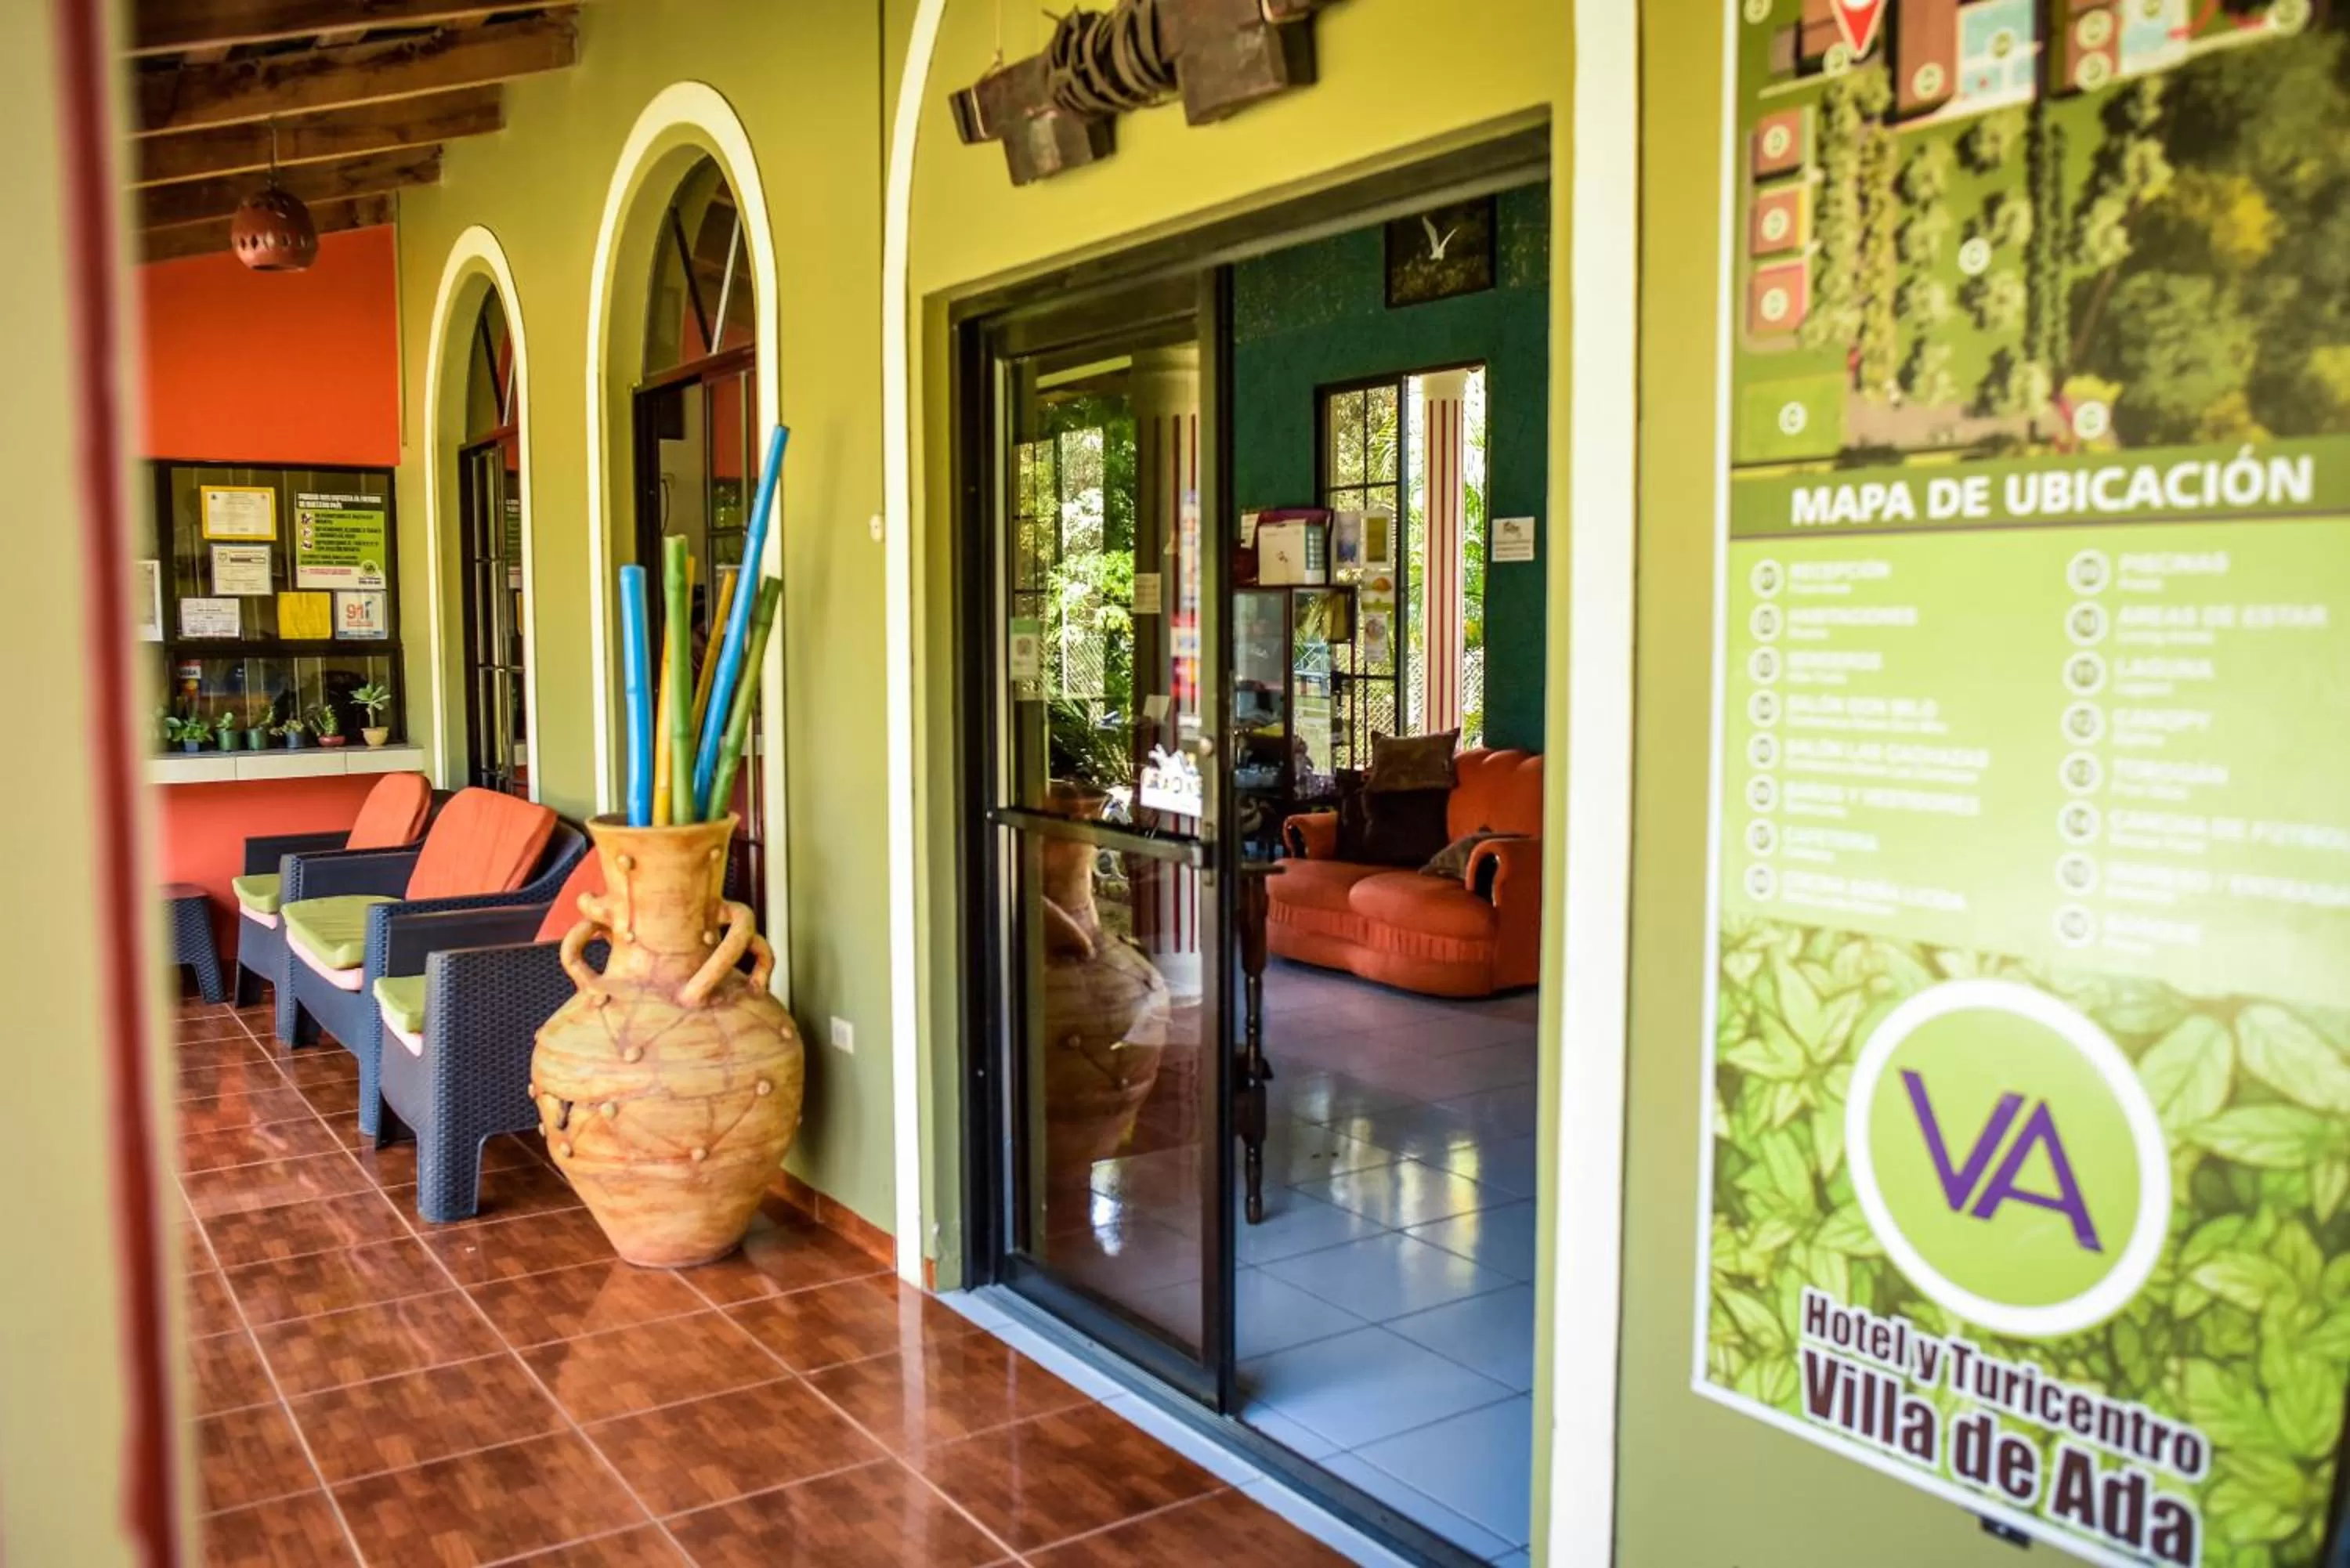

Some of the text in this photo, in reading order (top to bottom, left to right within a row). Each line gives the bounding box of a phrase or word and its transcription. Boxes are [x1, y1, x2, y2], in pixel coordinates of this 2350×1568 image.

[1790, 444, 2314, 526] MAPA DE UBICACIÓN
[1902, 1070, 2102, 1252] VA
[1802, 1348, 2193, 1566] Villa de Ada
[1806, 1293, 2204, 1475] Hotel y Turicentro
